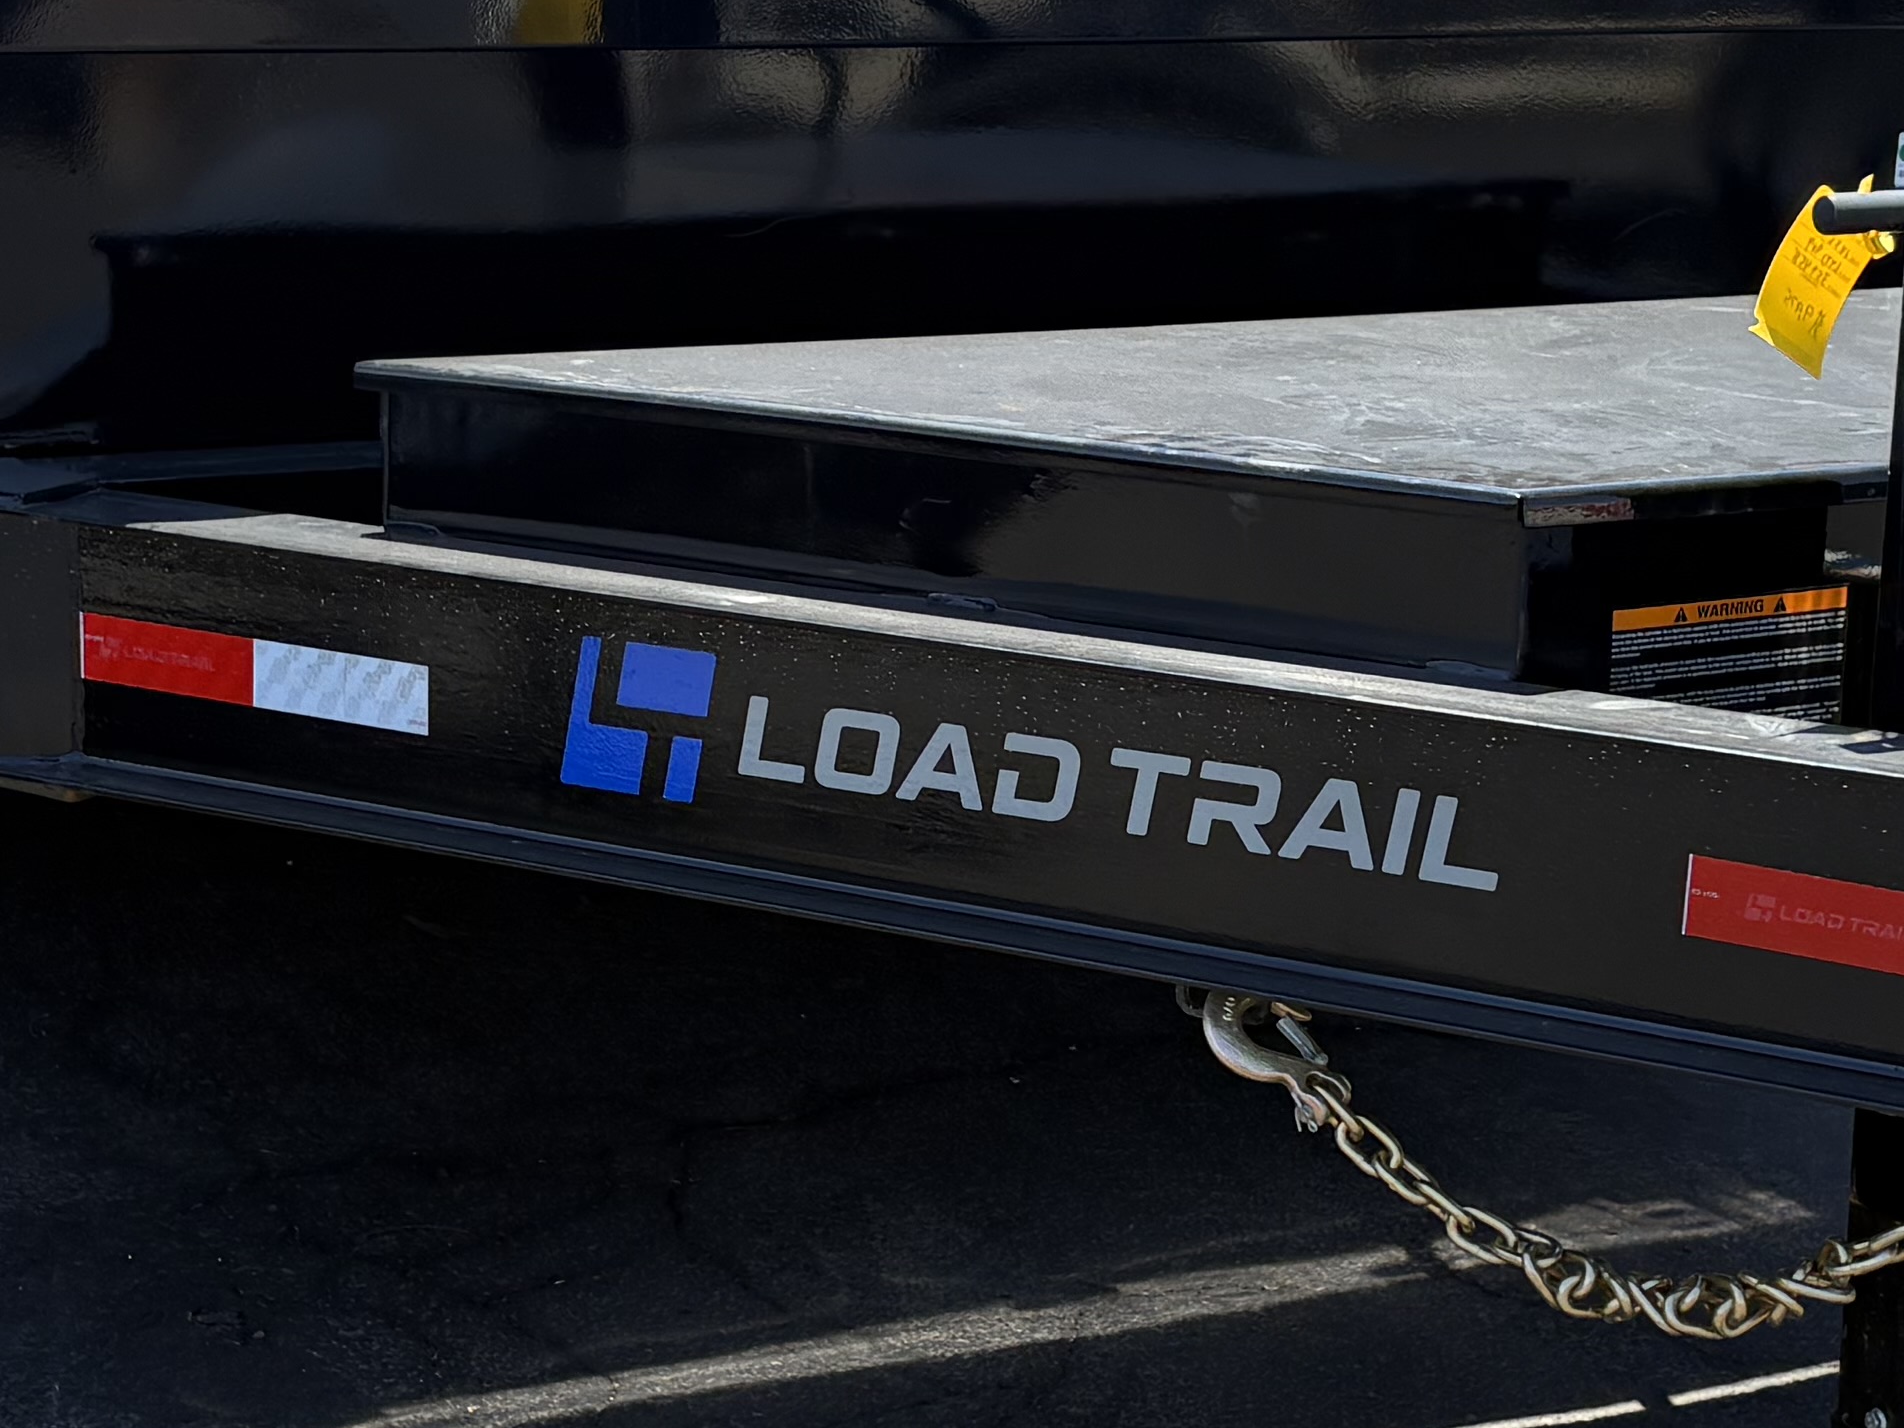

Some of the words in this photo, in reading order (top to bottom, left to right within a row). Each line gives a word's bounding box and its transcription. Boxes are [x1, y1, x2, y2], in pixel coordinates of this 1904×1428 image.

[1697, 598, 1765, 619] WARNING
[737, 695, 1081, 822] LOAD
[1110, 747, 1499, 892] TRAIL
[1778, 903, 1845, 930] LOAD
